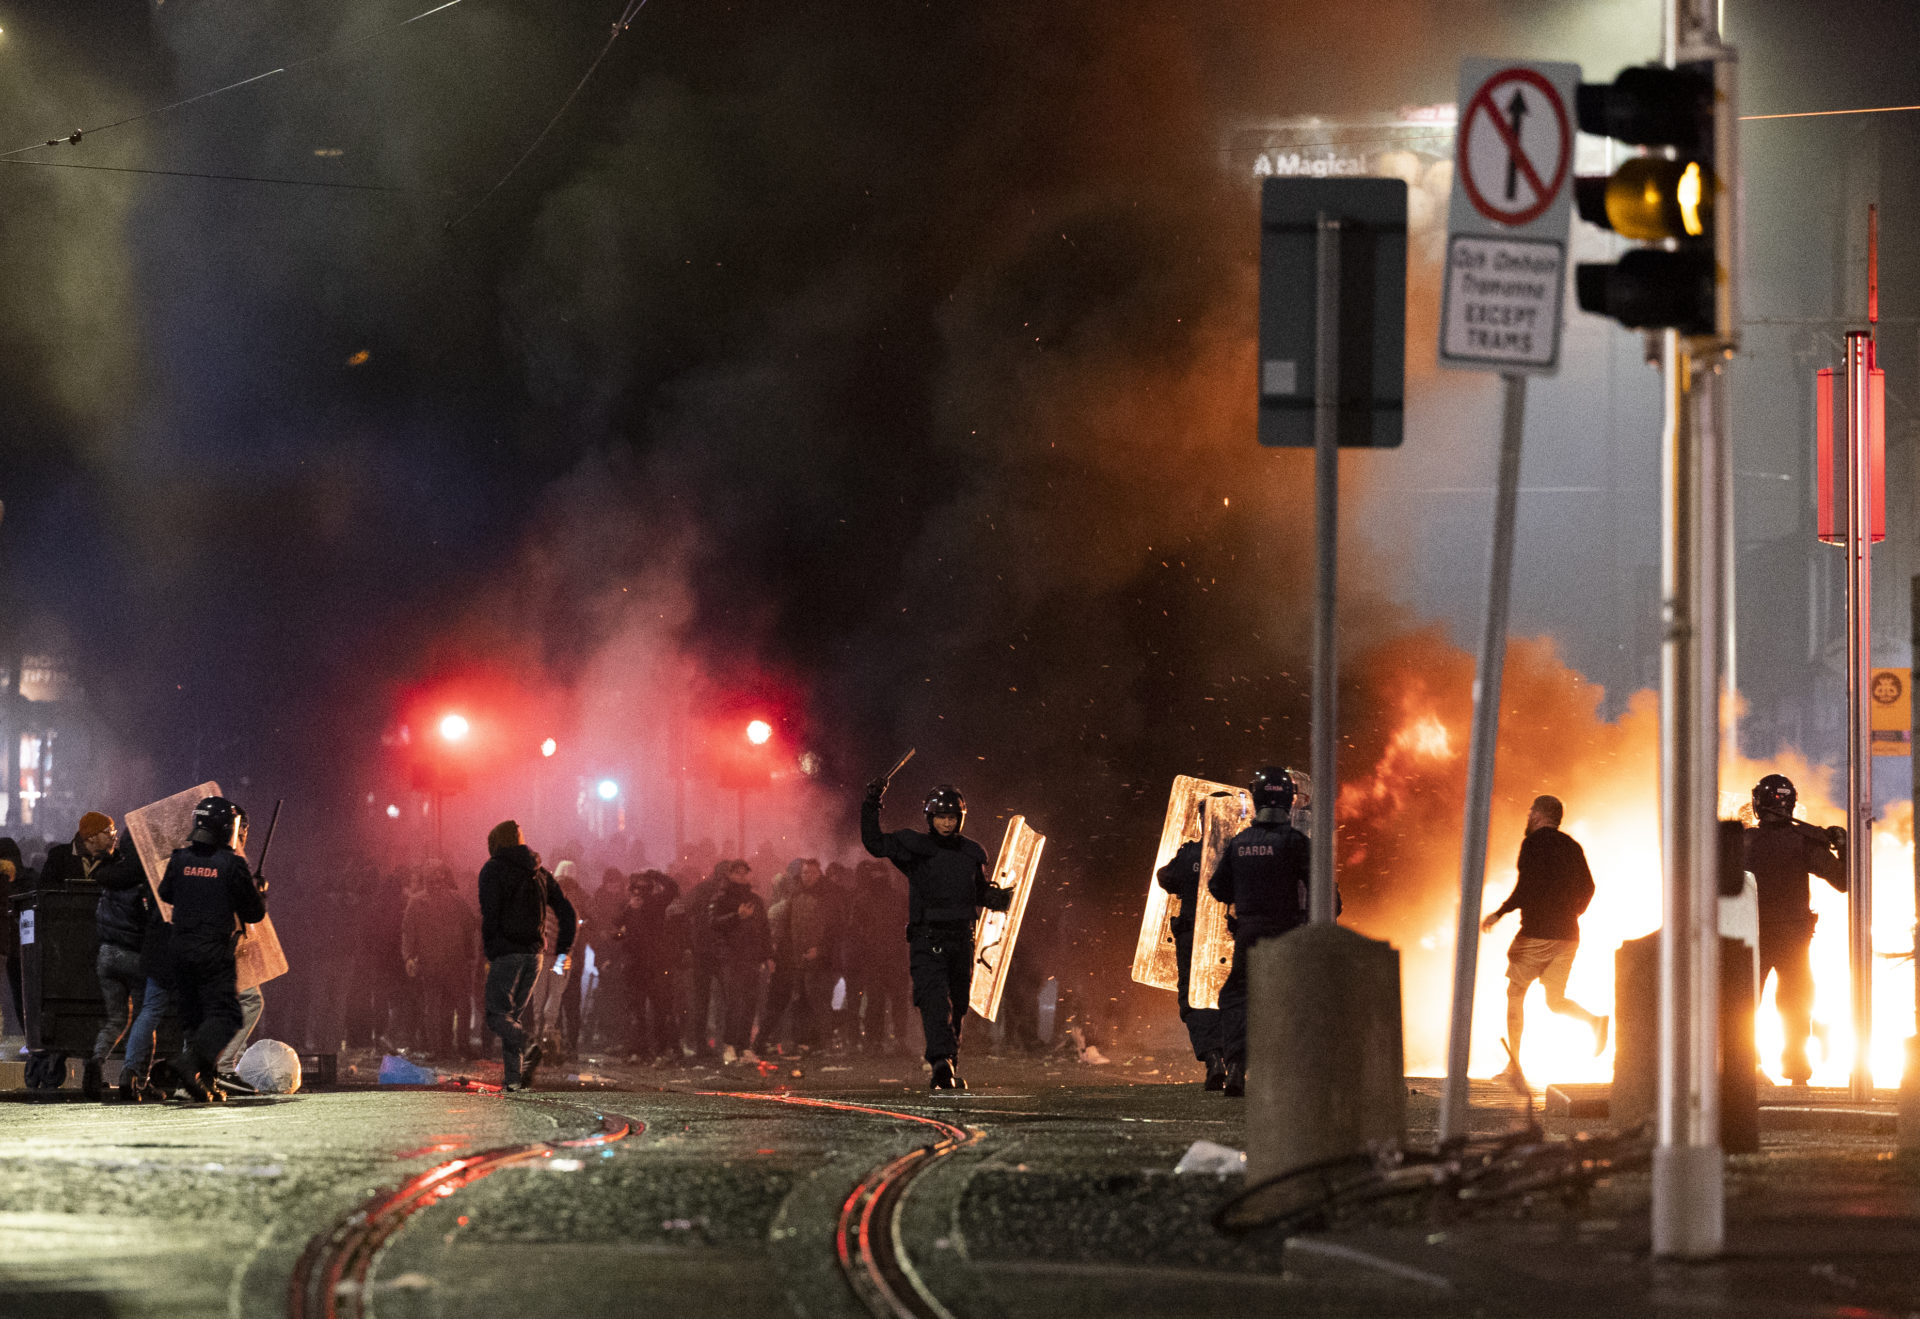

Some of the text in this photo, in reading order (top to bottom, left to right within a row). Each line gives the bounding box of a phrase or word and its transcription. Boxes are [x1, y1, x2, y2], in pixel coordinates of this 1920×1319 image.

[1253, 153, 1367, 178] A Magical
[1465, 303, 1536, 328] EXCEPT
[1468, 328, 1532, 353] TRAMS
[1238, 846, 1274, 856] GARDA
[184, 866, 218, 878] GARDA
